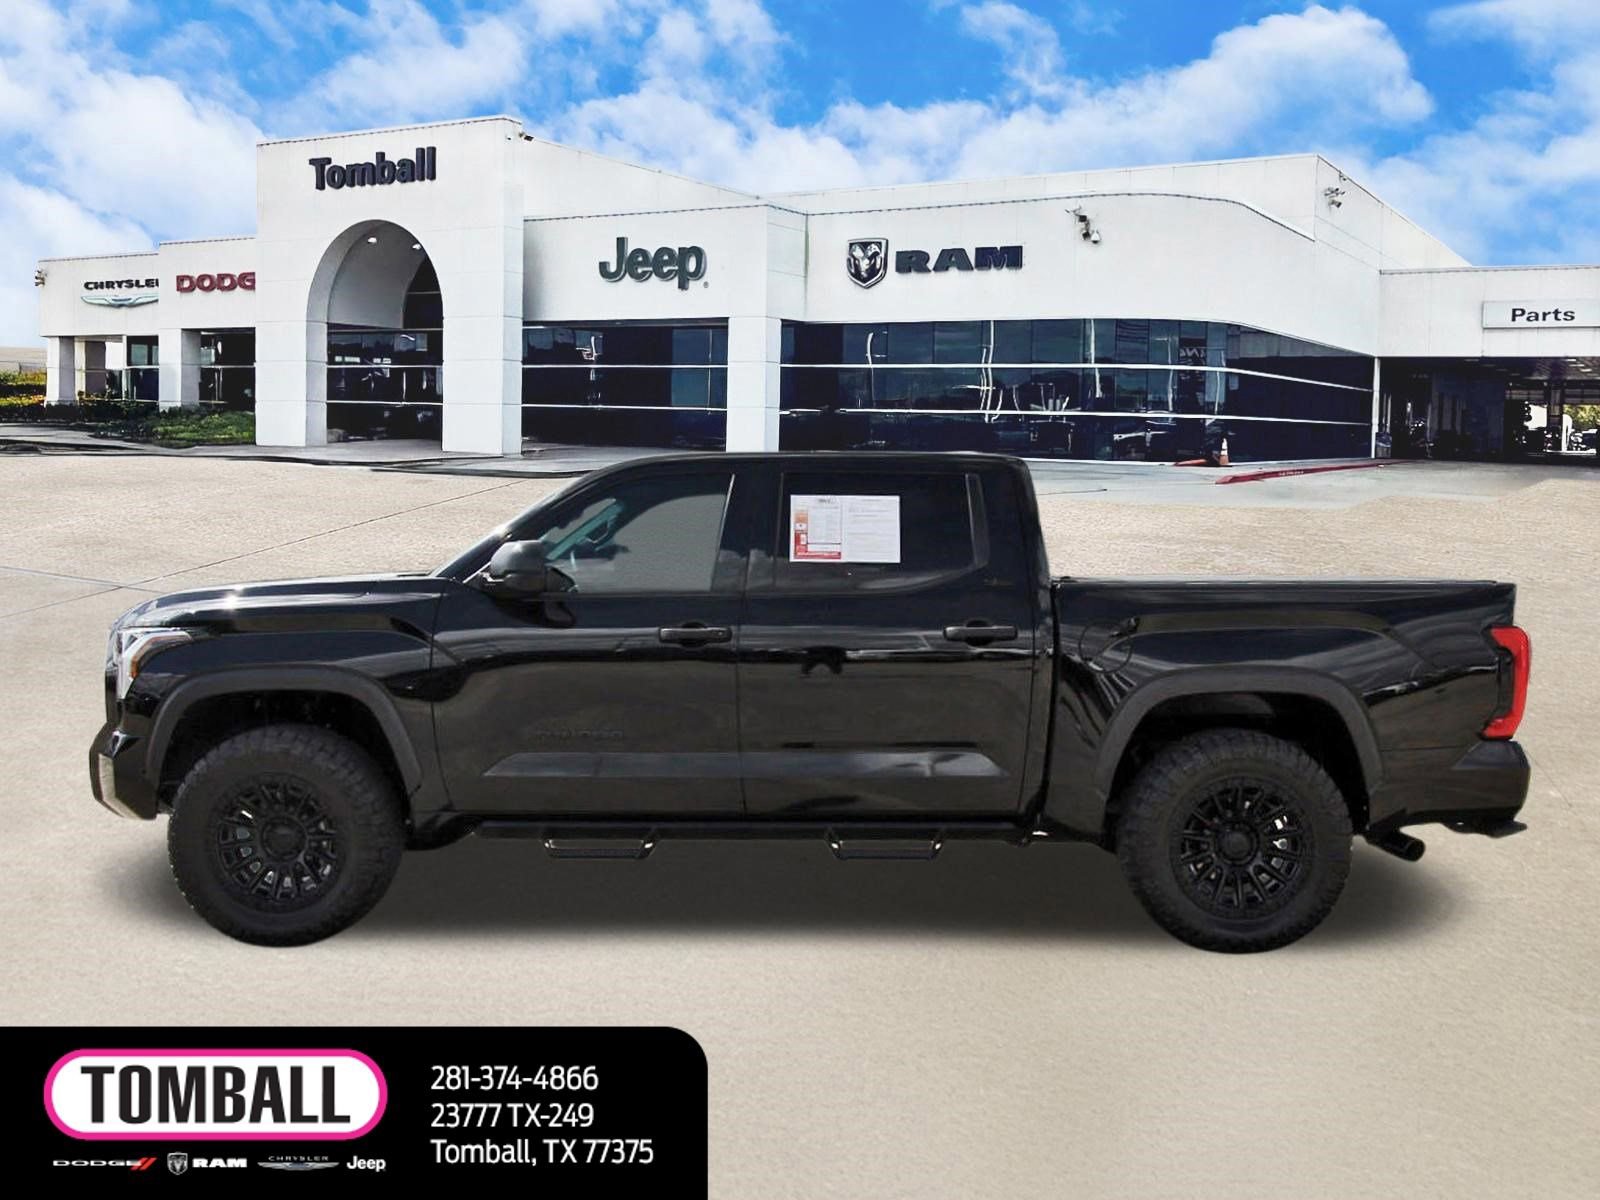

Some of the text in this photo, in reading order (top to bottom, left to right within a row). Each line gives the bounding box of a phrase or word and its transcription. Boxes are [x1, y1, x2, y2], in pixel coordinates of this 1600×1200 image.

[308, 146, 437, 191] Tomball
[598, 236, 708, 291] Jeep
[895, 245, 1023, 274] RAM
[83, 278, 160, 291] CHRYSLE
[1511, 307, 1576, 322] Parts
